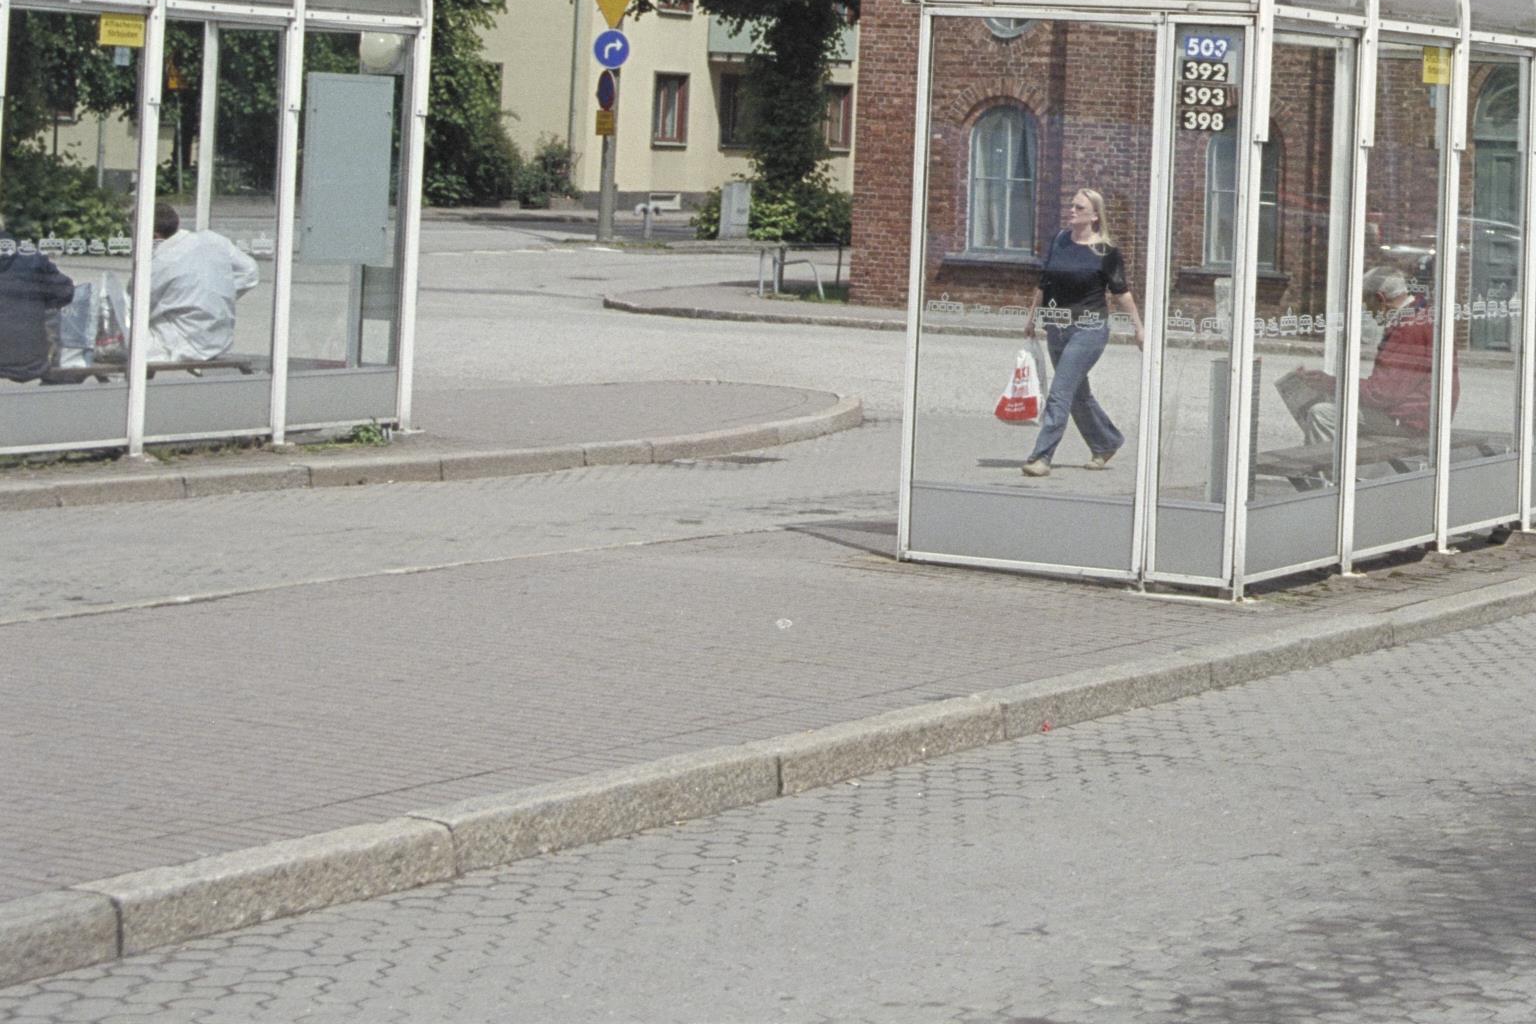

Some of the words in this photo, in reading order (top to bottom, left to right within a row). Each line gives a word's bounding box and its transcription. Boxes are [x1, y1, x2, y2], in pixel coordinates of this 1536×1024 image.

[1187, 37, 1228, 57] 503
[1185, 61, 1226, 81] 392
[1184, 86, 1225, 106] 393
[1184, 111, 1224, 131] 398
